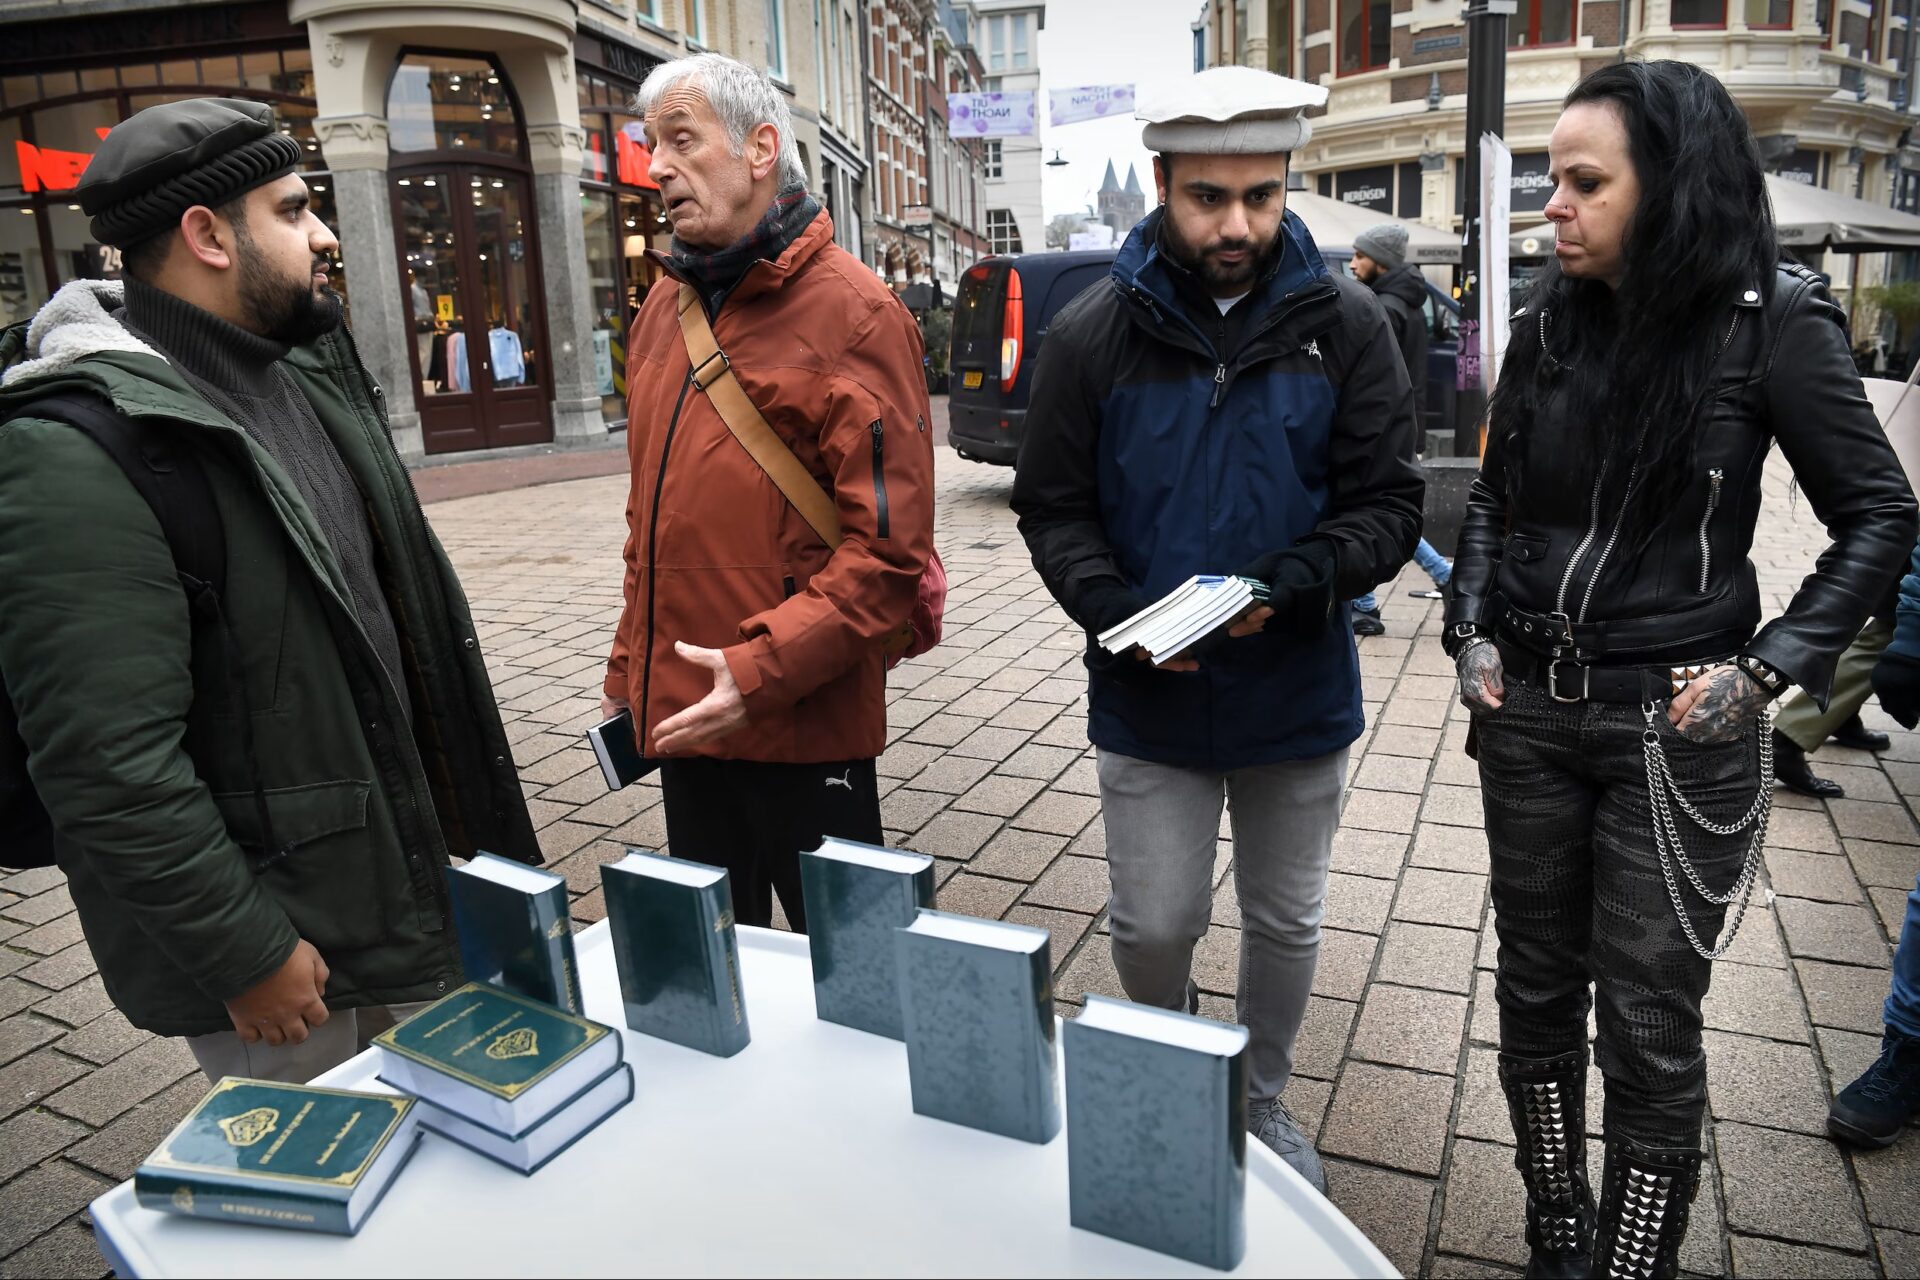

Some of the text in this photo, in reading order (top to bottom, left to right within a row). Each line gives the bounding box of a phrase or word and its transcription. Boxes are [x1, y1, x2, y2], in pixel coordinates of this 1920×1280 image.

[1342, 187, 1386, 203] BERENSEN
[1417, 248, 1459, 258] BERENSEN
[1300, 342, 1317, 350] NOR
